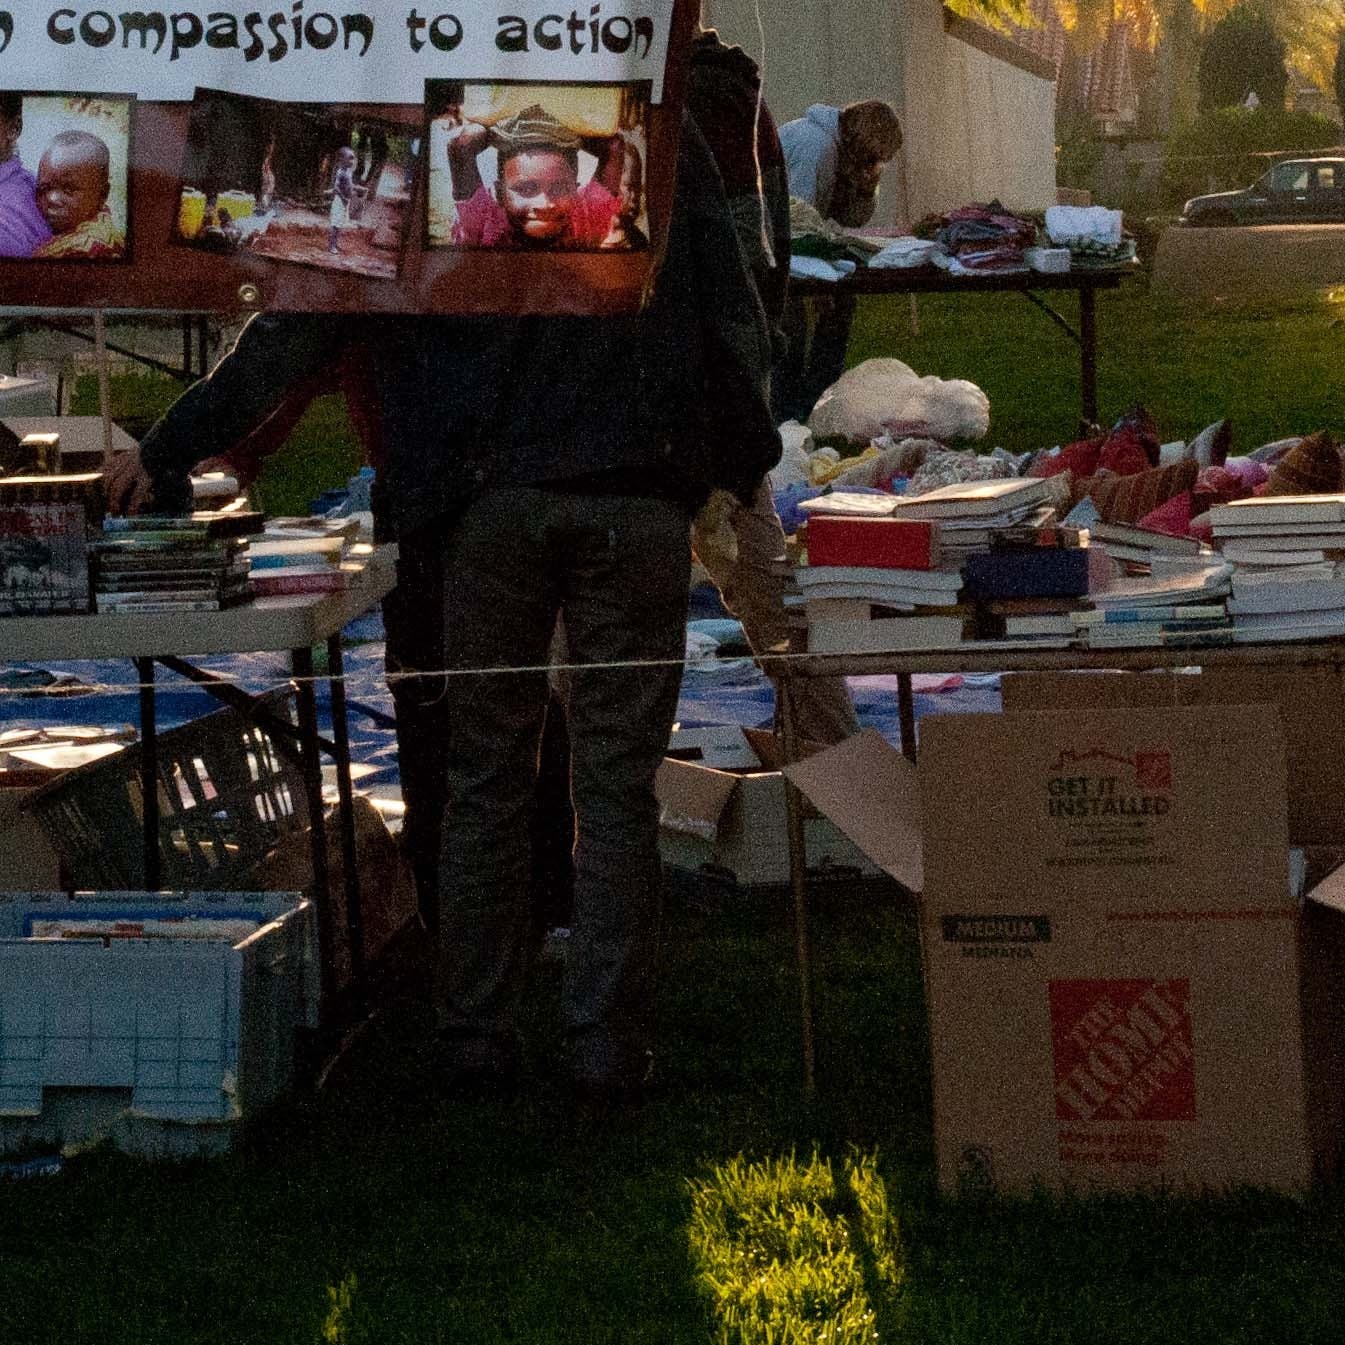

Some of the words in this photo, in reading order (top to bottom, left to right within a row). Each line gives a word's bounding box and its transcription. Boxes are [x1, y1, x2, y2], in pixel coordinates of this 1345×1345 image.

[405, 7, 464, 53] to
[494, 3, 656, 60] action
[1047, 776, 1088, 797] GET
[1098, 776, 1118, 795] IT
[1048, 795, 1171, 817] INSTALLED
[955, 920, 1036, 938] MEDIUM
[1055, 978, 1184, 1119] HOME
